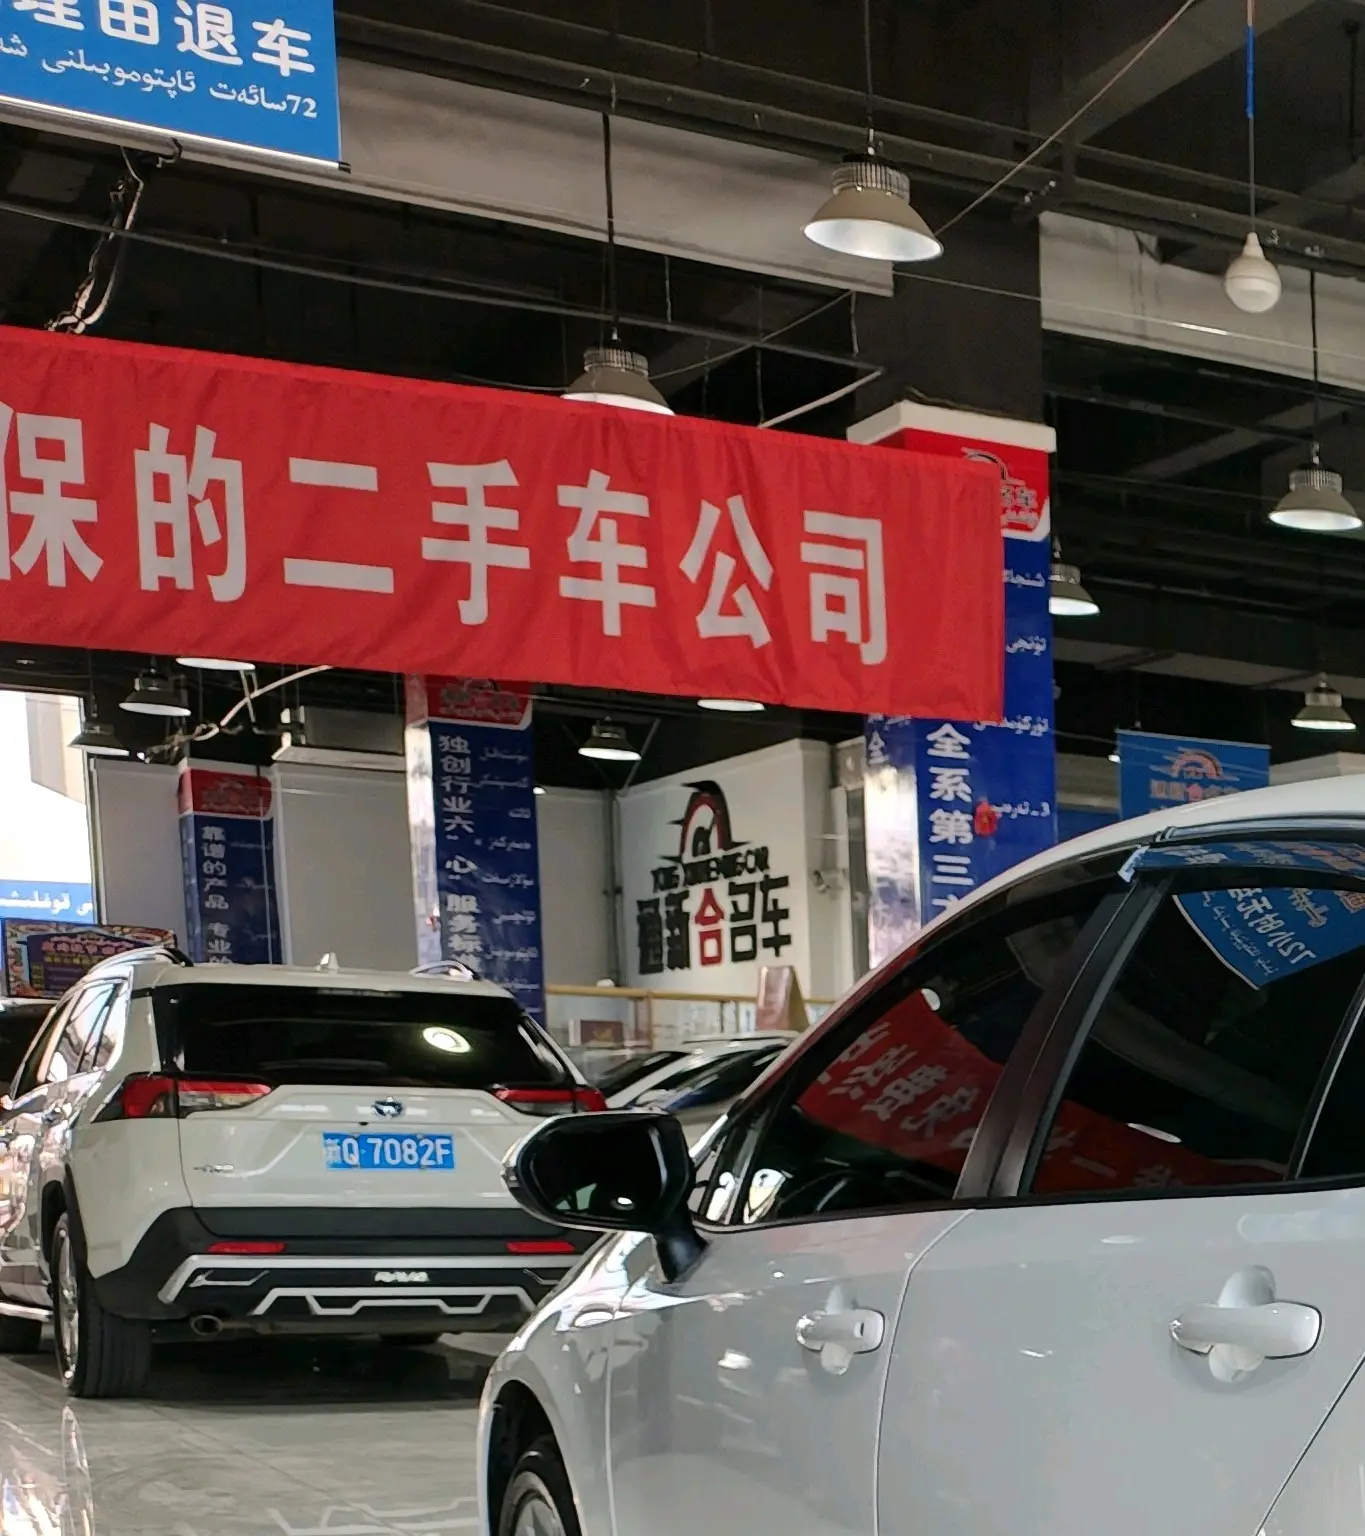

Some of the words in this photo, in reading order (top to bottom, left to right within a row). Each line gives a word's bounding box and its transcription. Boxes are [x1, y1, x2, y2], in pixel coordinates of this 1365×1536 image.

[0, 408, 889, 666] 保的二手车公司
